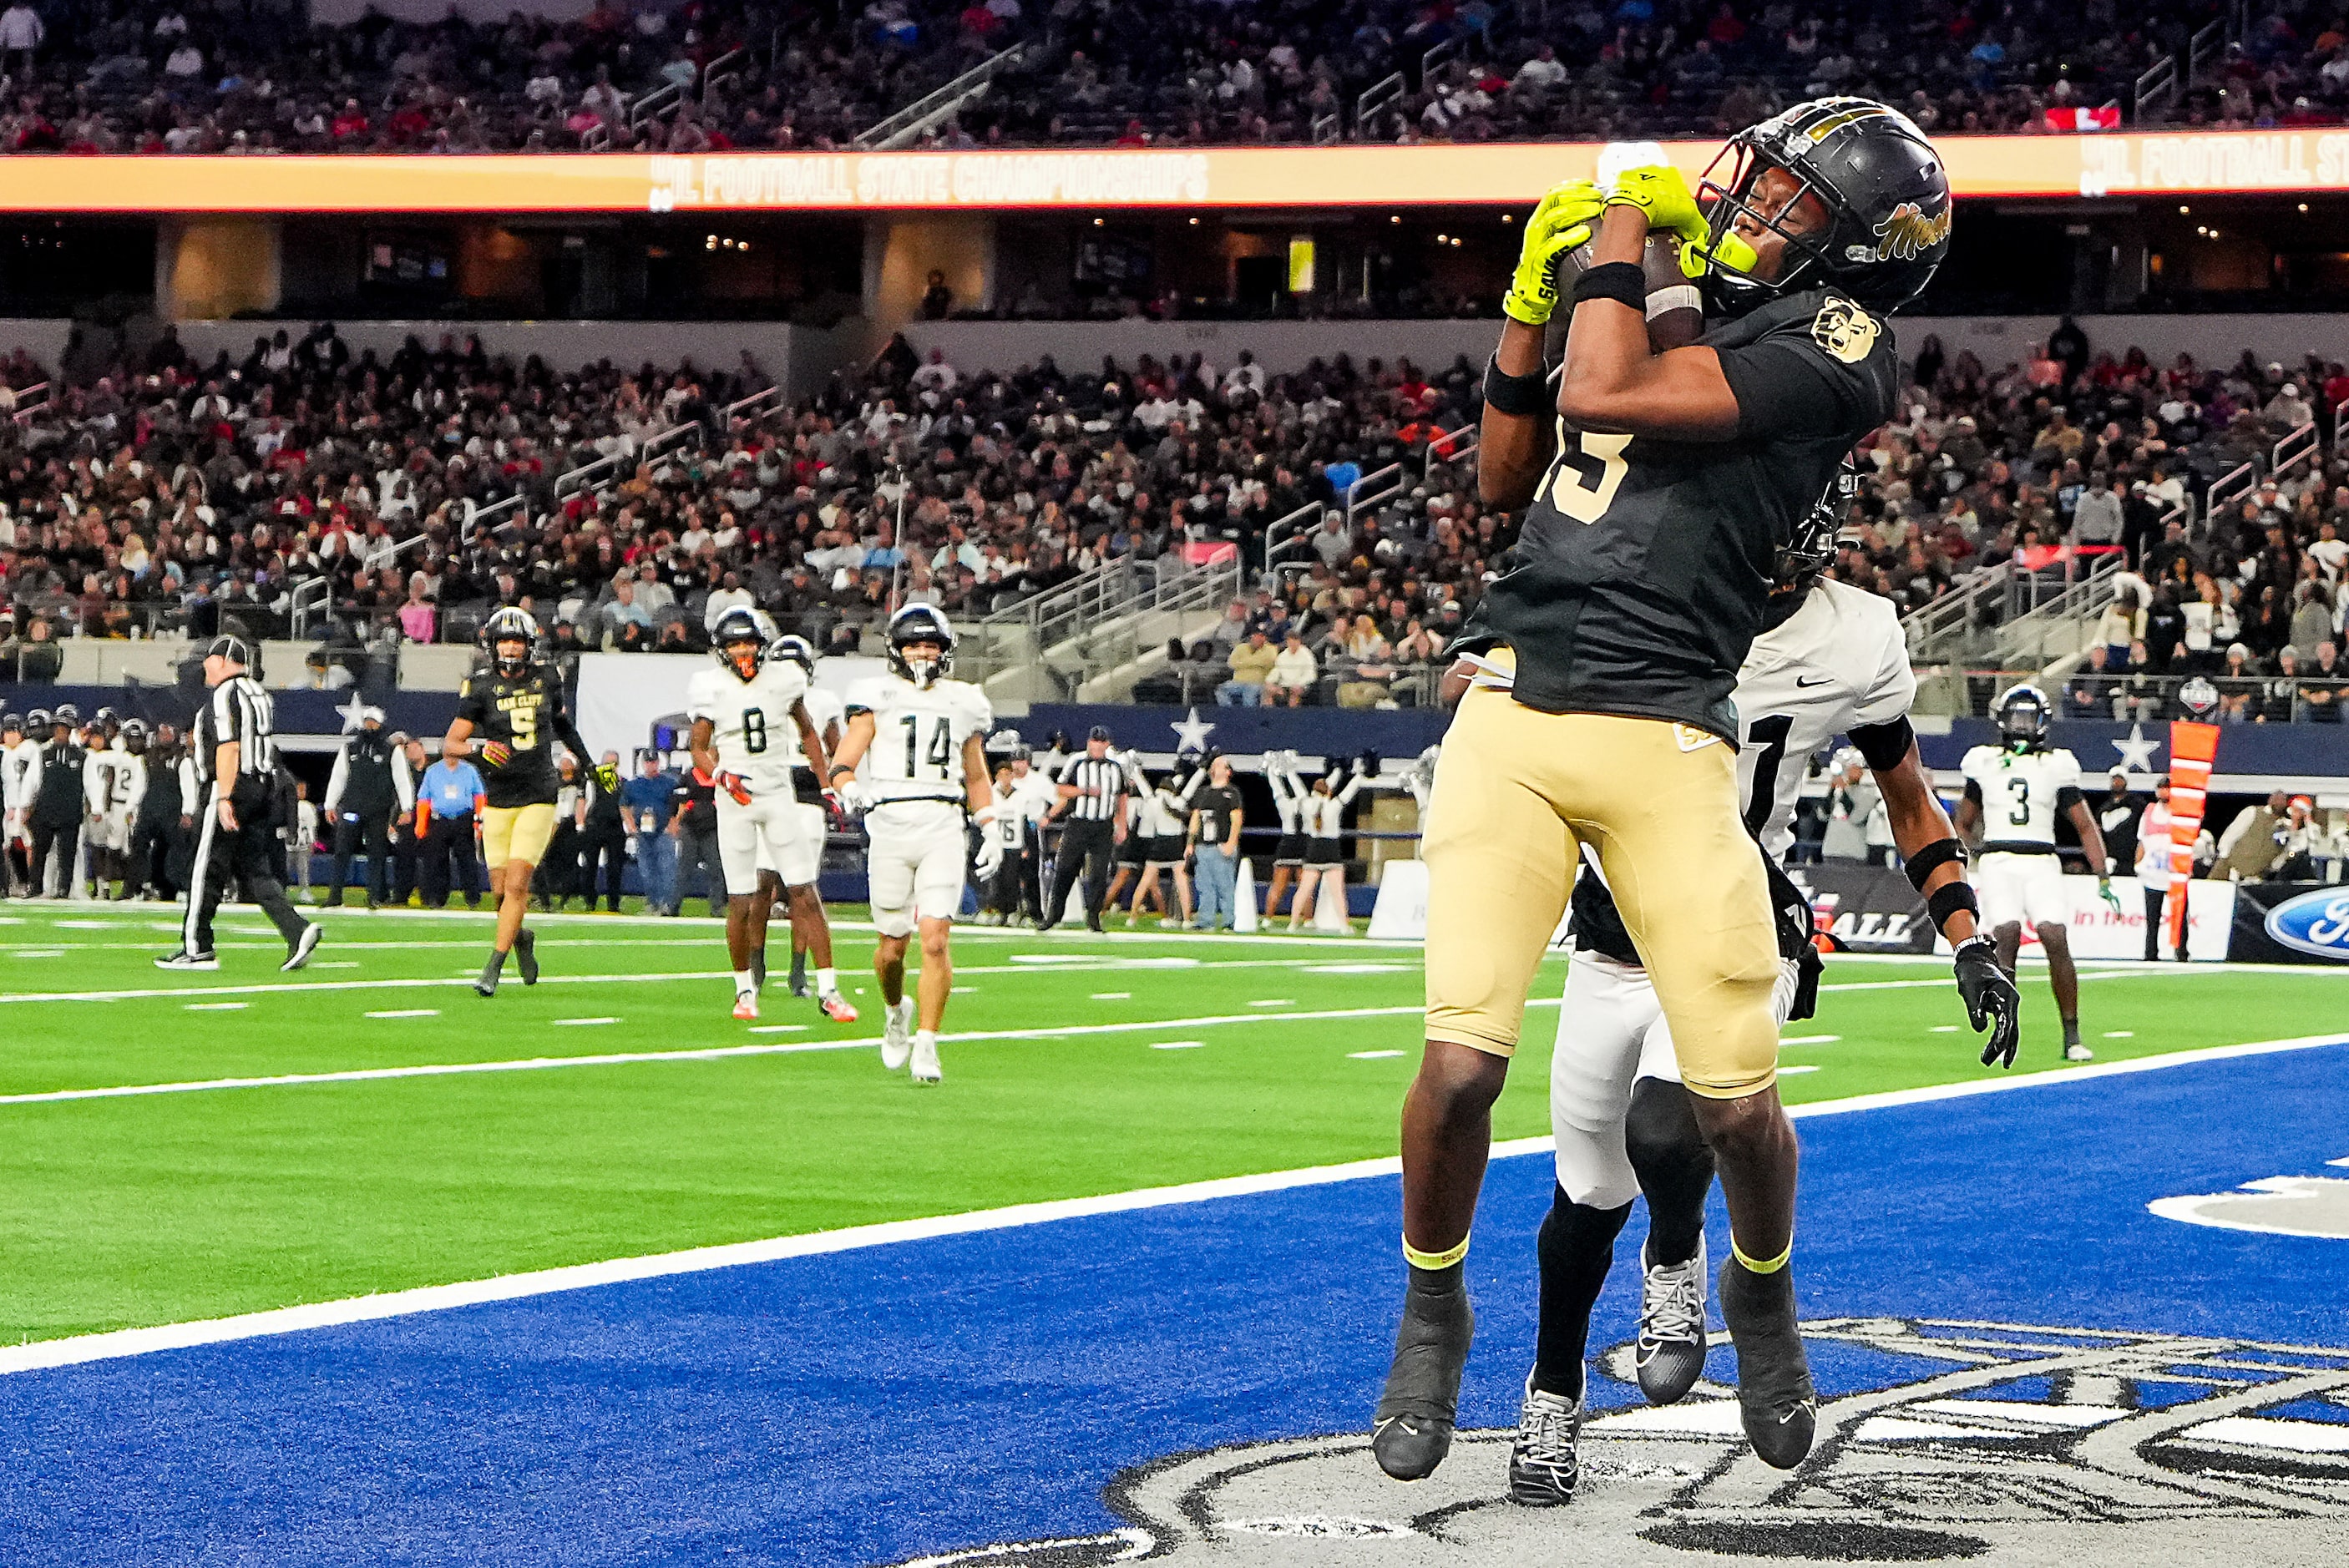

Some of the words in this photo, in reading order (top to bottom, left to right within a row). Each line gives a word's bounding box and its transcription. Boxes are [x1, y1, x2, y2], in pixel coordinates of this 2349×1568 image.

[704, 157, 854, 204] FOOTBALL
[857, 156, 947, 203] STATE
[953, 154, 1209, 202] CHAMPIONSHIPS
[2143, 136, 2310, 186] FOOTBALL
[509, 706, 537, 751] 5
[742, 706, 767, 753] 8
[899, 714, 950, 780] 14
[2007, 776, 2030, 826] 3
[2074, 909, 2094, 925] in
